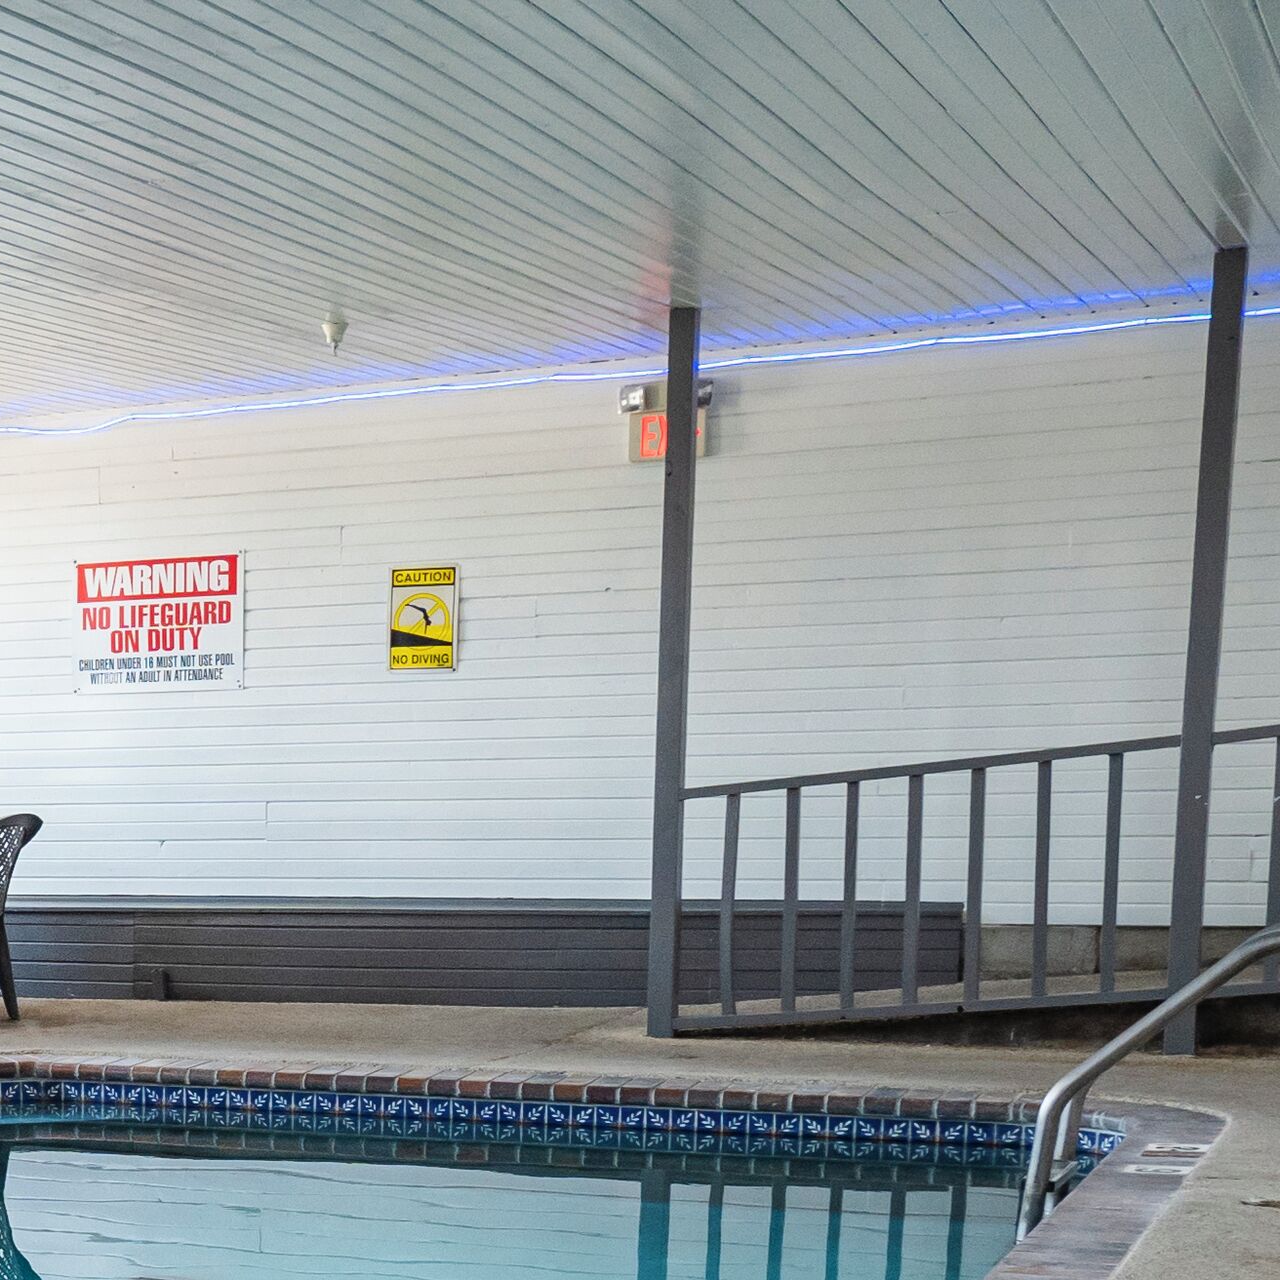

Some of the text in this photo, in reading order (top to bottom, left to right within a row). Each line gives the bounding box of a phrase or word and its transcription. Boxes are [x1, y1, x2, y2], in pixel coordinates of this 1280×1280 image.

[84, 560, 229, 598] WARNING
[395, 571, 451, 583] CAUTION
[82, 600, 232, 630] NO LIFEGUARD
[111, 627, 201, 654] ON DUTY
[79, 658, 114, 671] CHILDREN
[117, 657, 141, 670] UNDER
[156, 656, 178, 668] MUST
[180, 655, 196, 667] NOT
[198, 654, 213, 666] USE
[215, 653, 235, 666] POOL
[392, 653, 449, 664] NO DIVING
[90, 668, 223, 684] WITHOUT AN ADULT IN ATTENDANCE
